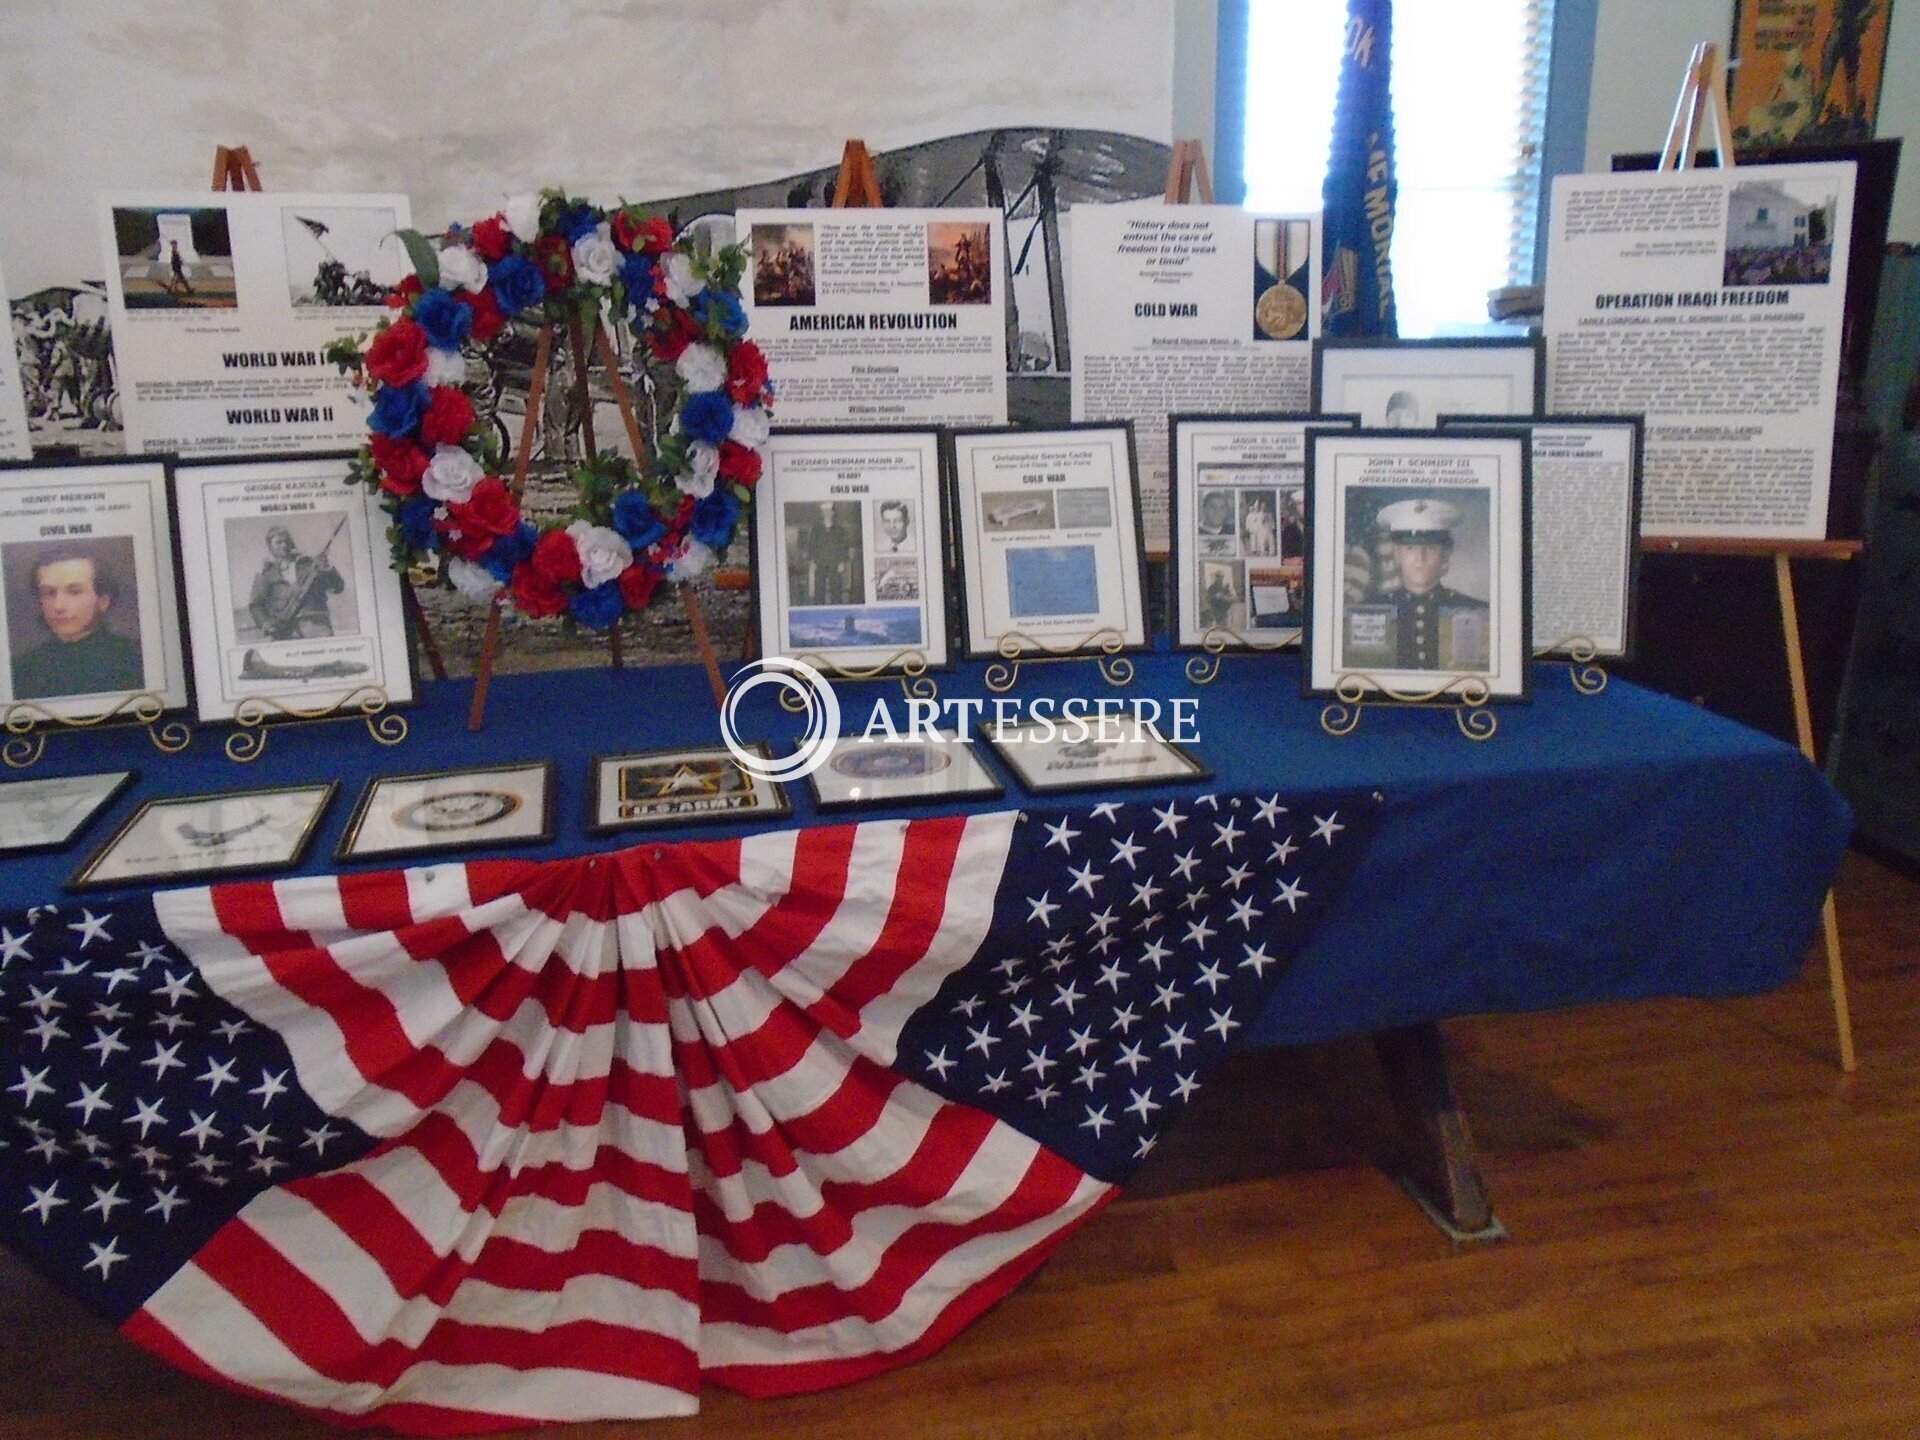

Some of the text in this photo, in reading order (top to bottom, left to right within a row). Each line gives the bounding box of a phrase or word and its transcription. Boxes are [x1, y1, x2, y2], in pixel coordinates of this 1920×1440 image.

[1160, 233, 1176, 241] the
[1202, 232, 1213, 241] of
[1118, 244, 1158, 254] freedom
[1160, 245, 1171, 253] to
[1173, 244, 1189, 253] the
[1596, 289, 1789, 309] OPERATION IRAQI FREEDOM
[1135, 303, 1198, 318] COLD WAR
[789, 312, 958, 331] AMERICAN REVOLUTION
[222, 352, 278, 368] WORLD
[281, 352, 317, 367] WAR
[226, 407, 334, 425] WORLD WAR II
[1368, 458, 1394, 466] JOHN
[1409, 459, 1453, 467] SCHMIDT
[1023, 473, 1066, 484] COLD WAR
[1359, 476, 1408, 484] OPERATION
[1439, 476, 1479, 484] FREEDOM
[244, 483, 282, 492] GEORGE
[830, 484, 869, 494] COLD WAR
[21, 494, 57, 504] HENRY
[261, 504, 287, 513] WORLD
[289, 502, 307, 511] WAR
[40, 523, 92, 536] CIVIL WAR
[679, 797, 742, 813] ARMY
